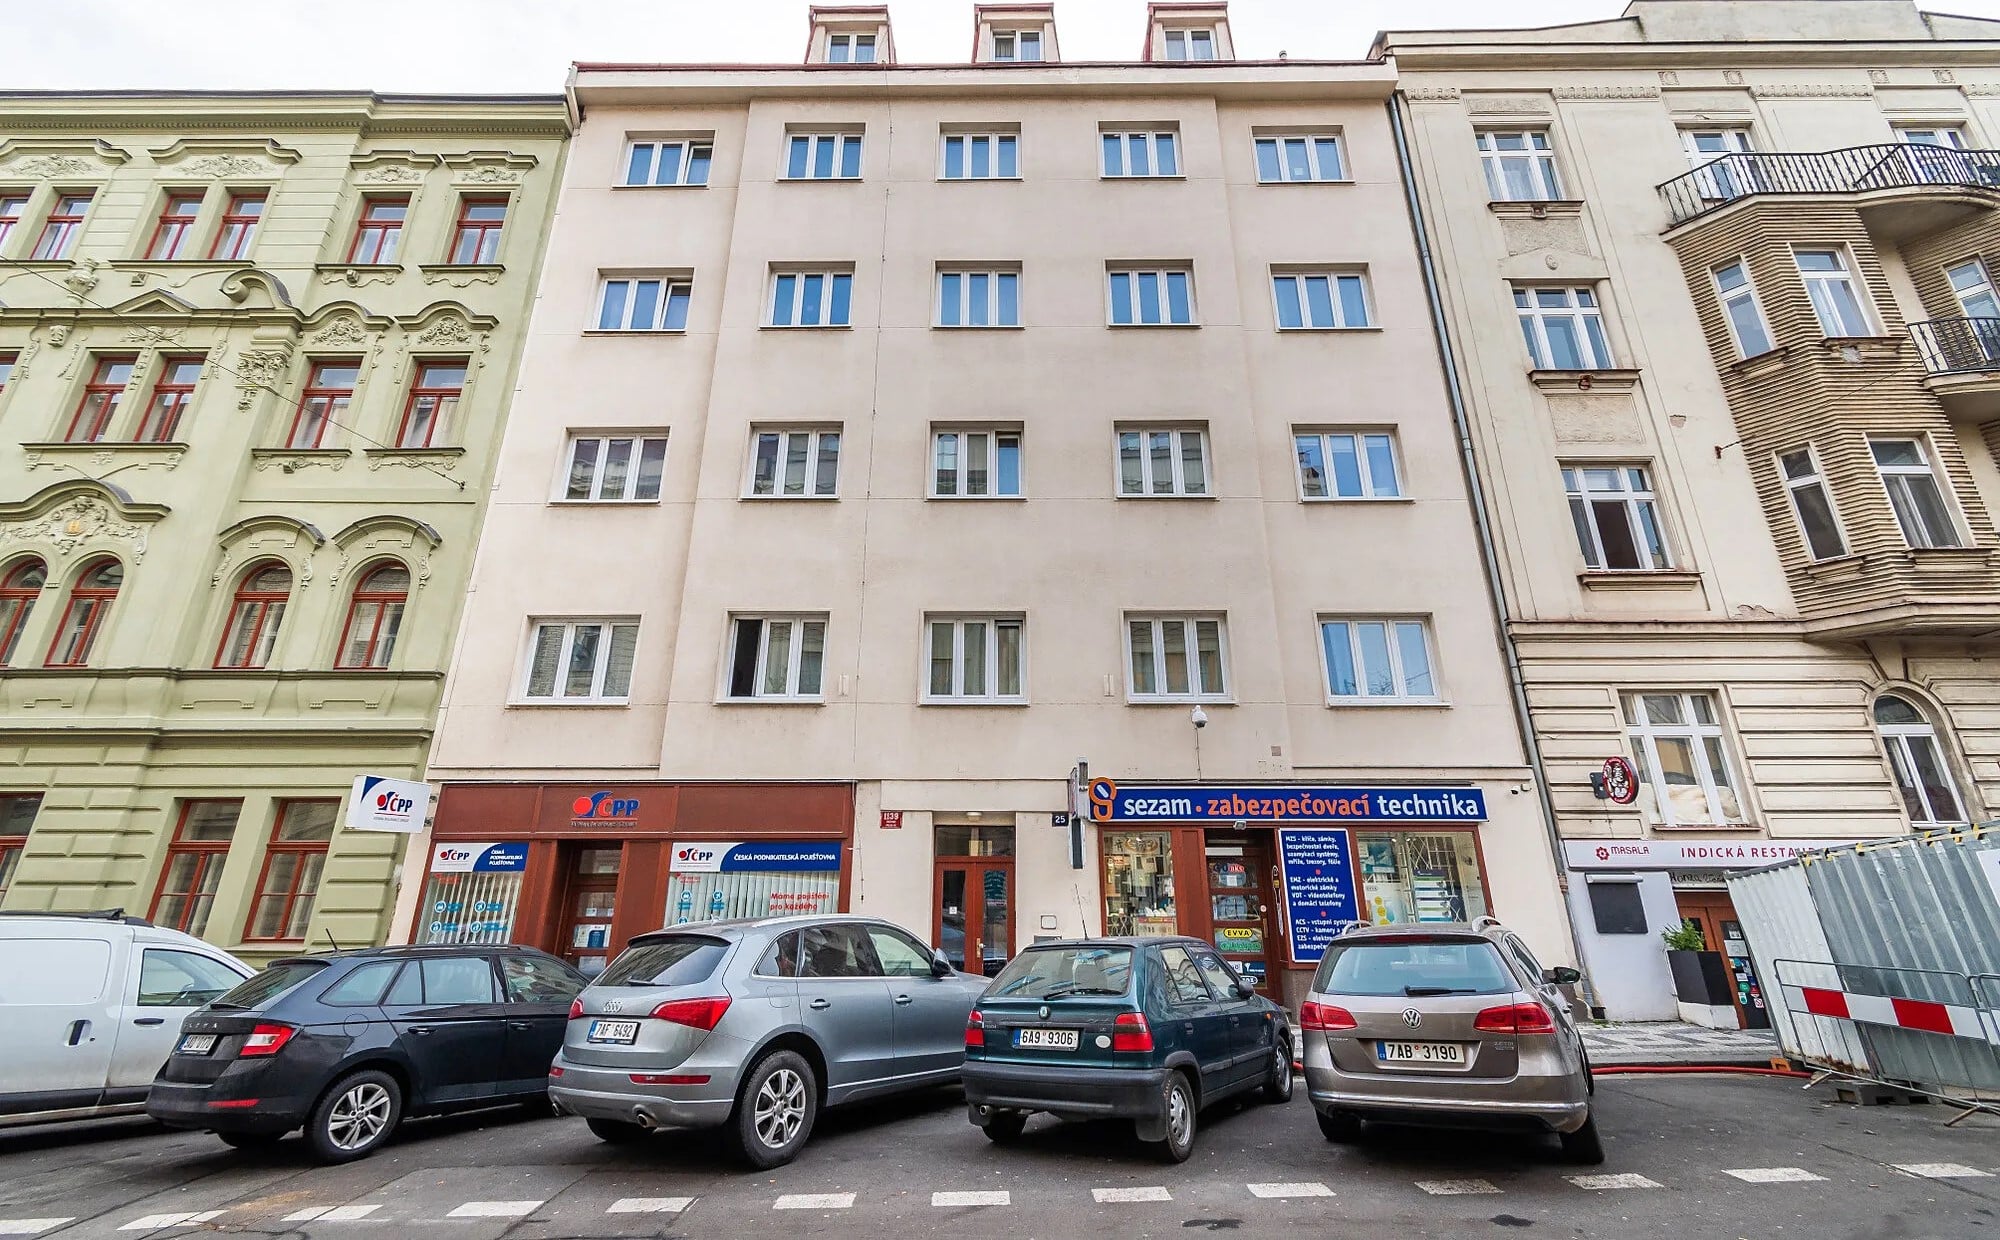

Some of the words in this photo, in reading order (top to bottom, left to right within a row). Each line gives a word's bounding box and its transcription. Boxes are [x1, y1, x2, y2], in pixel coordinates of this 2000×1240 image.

[390, 793, 413, 812] ČPP
[1124, 798, 1192, 816] sezam
[1207, 793, 1370, 820] zabezpečovací
[1377, 793, 1479, 816] technika
[883, 812, 899, 820] 1139
[1055, 815, 1066, 824] 25
[691, 849, 714, 861] ČPP
[733, 853, 753, 861] ČESKÁ
[753, 853, 800, 861] PODNIKATELSKÁ
[1610, 846, 1650, 855] MASALA
[1680, 845, 1745, 858] INDICKÁ
[1751, 847, 1816, 858] RESTA
[1227, 929, 1250, 937] EVVA
[594, 1023, 612, 1037] 7AF
[613, 1023, 633, 1038] 6492
[1022, 1031, 1041, 1044] 6A9
[1047, 1031, 1074, 1046] 9306
[1387, 1043, 1413, 1059] 7AB
[1422, 1045, 1457, 1061] 3190
